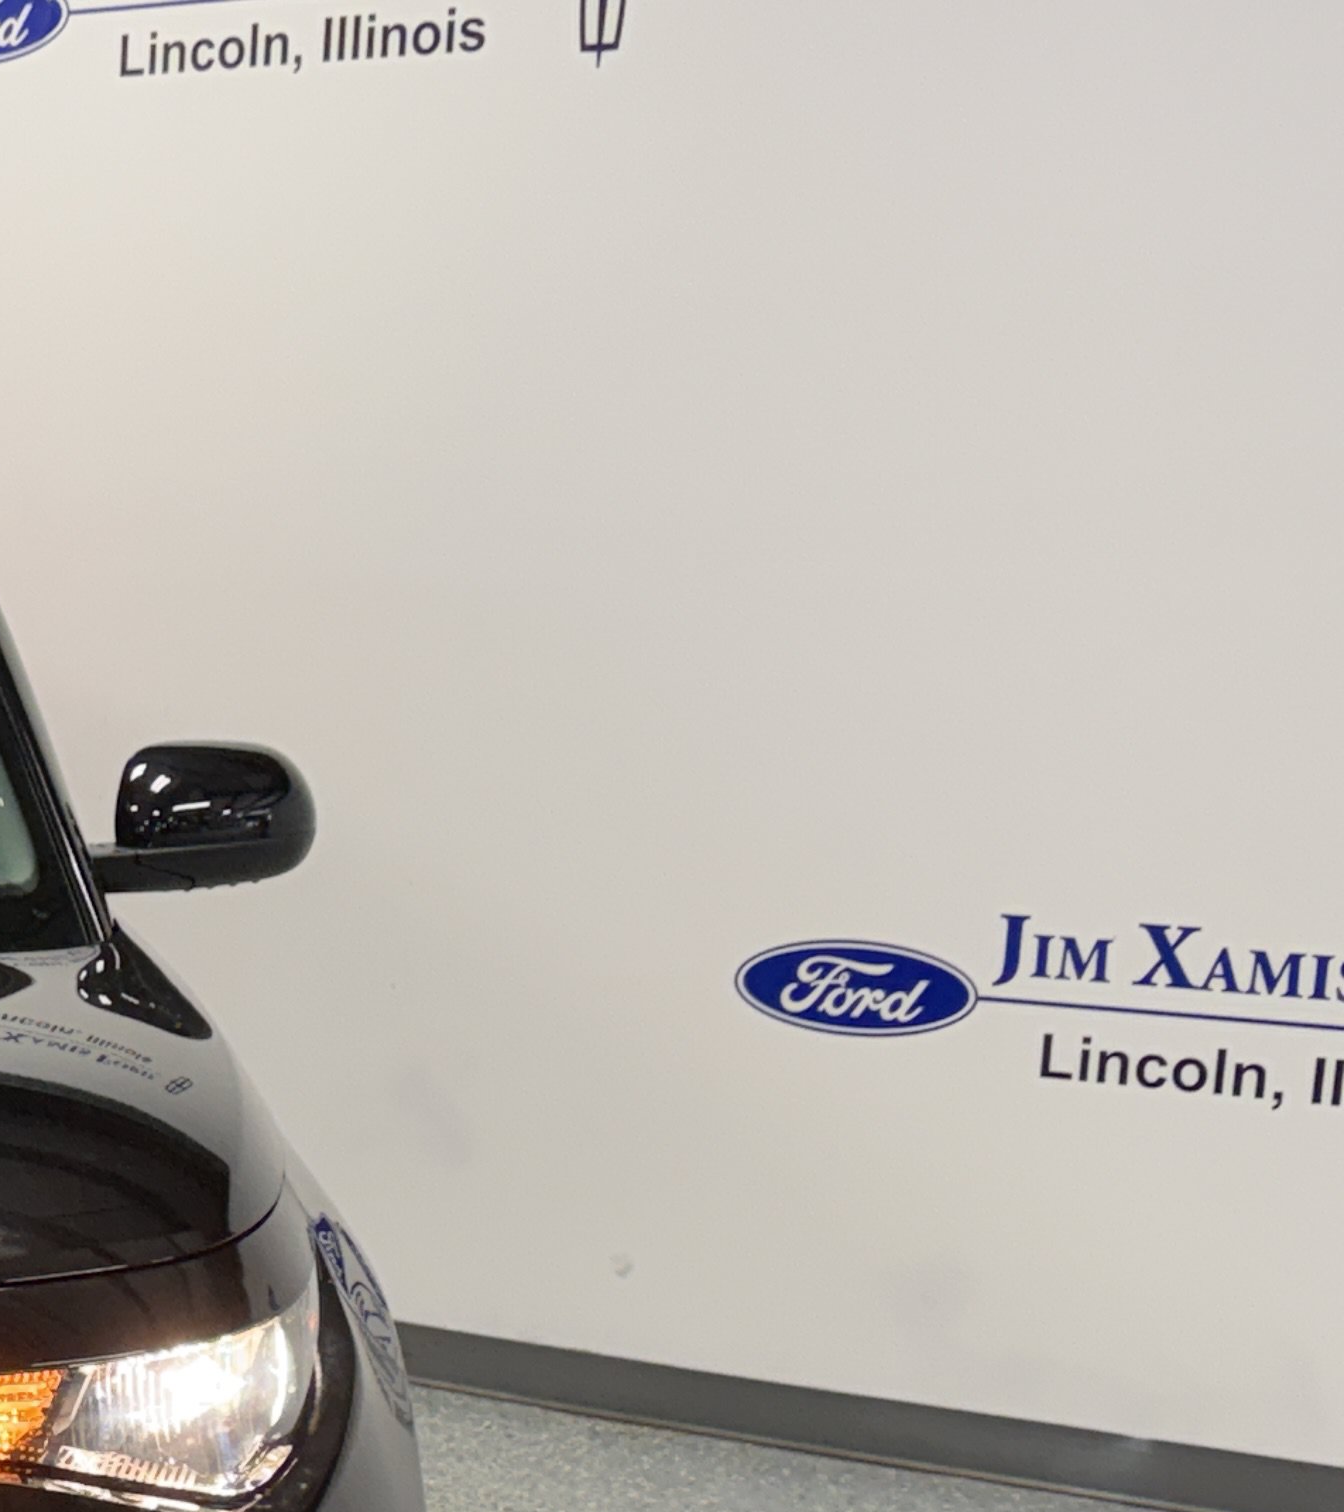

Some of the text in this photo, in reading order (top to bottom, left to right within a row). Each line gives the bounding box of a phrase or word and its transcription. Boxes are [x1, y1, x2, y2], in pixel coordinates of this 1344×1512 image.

[119, 8, 486, 77] Lincoln, Illinois
[779, 954, 931, 1023] Ford
[1039, 1033, 1284, 1111] Lincoln,
